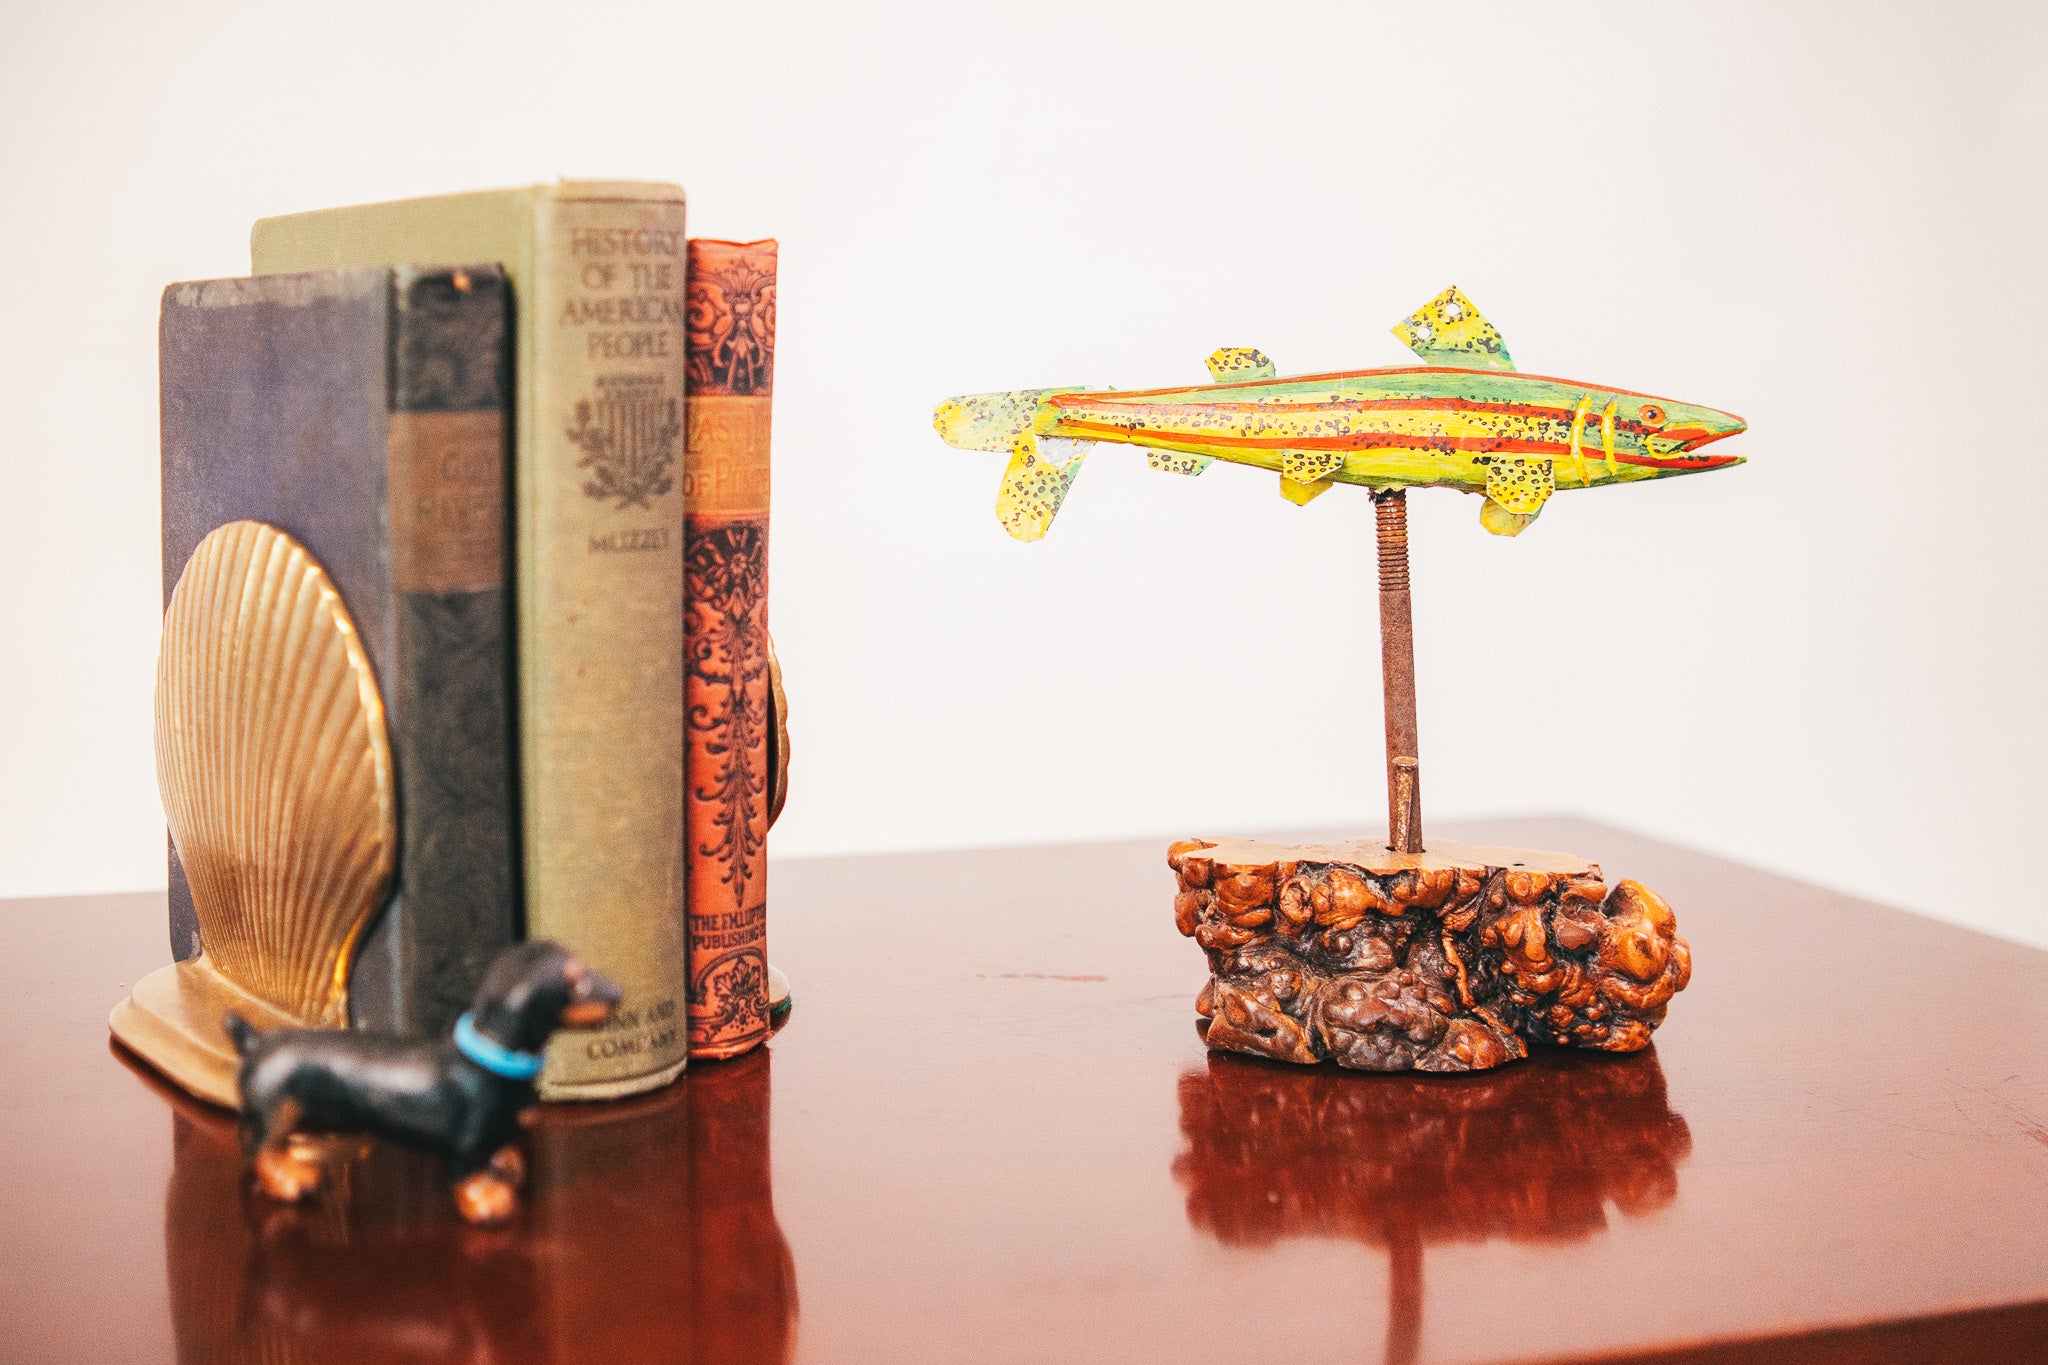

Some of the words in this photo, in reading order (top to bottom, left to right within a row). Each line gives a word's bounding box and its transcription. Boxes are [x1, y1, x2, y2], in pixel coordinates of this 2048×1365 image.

[571, 227, 680, 256] HISTORY
[581, 262, 614, 290] OF
[627, 262, 672, 290] THE
[588, 331, 669, 359] PEOPLE
[690, 914, 719, 931] THE
